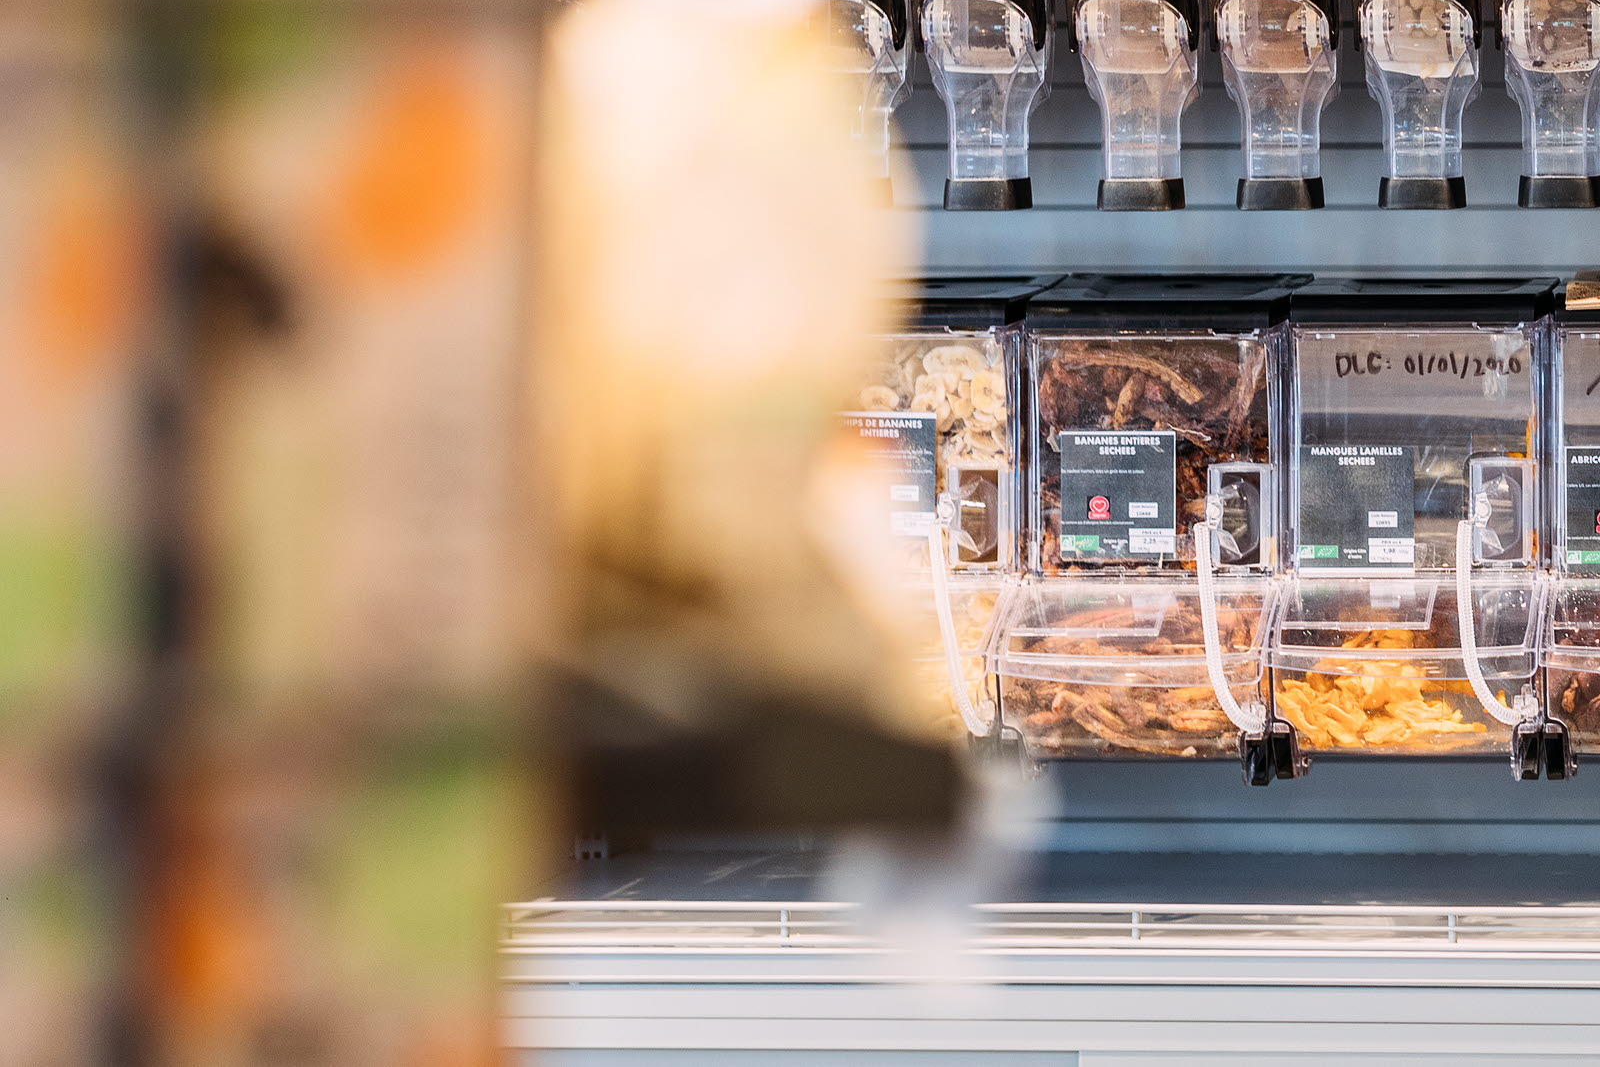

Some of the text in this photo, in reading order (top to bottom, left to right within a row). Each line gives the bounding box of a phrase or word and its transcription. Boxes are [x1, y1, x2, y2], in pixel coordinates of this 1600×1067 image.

[1335, 350, 1392, 378] DLC:
[865, 418, 923, 429] DE BANANES
[860, 428, 900, 438] ENTIERES
[1074, 436, 1161, 446] BANANES ENTIERES
[1099, 446, 1136, 455] SECHEES
[1310, 447, 1403, 456] MANGUES LAMELLES
[1338, 456, 1376, 466] SECHEES
